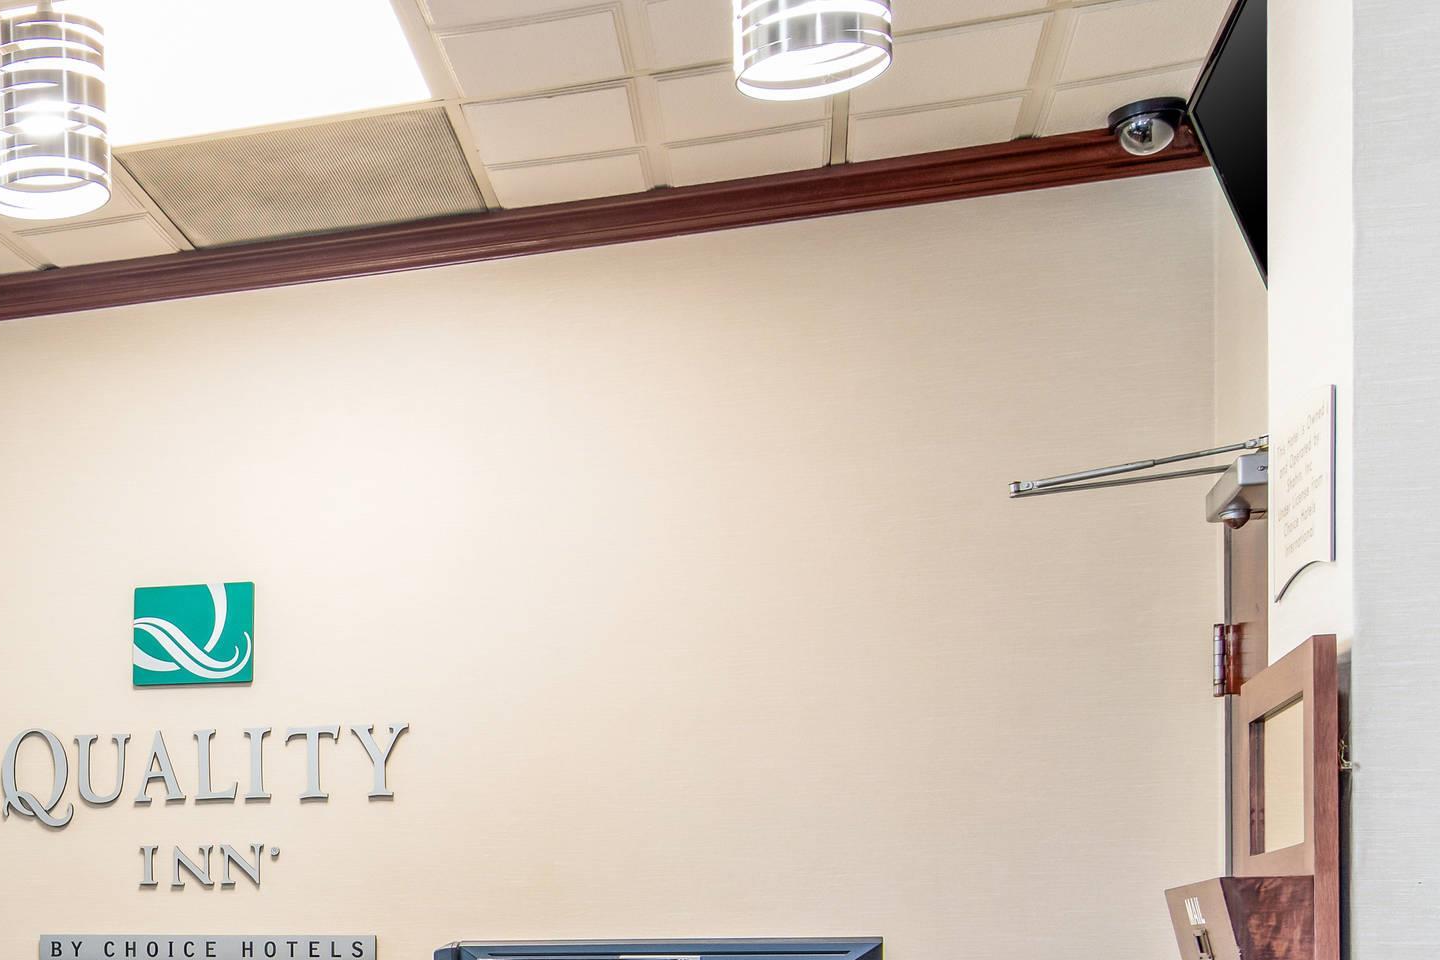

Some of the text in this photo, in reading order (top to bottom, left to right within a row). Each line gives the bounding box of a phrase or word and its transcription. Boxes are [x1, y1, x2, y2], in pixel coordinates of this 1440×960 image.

[1, 722, 410, 828] QUALITY
[51, 941, 364, 958] BY CHOICE HOTELS
